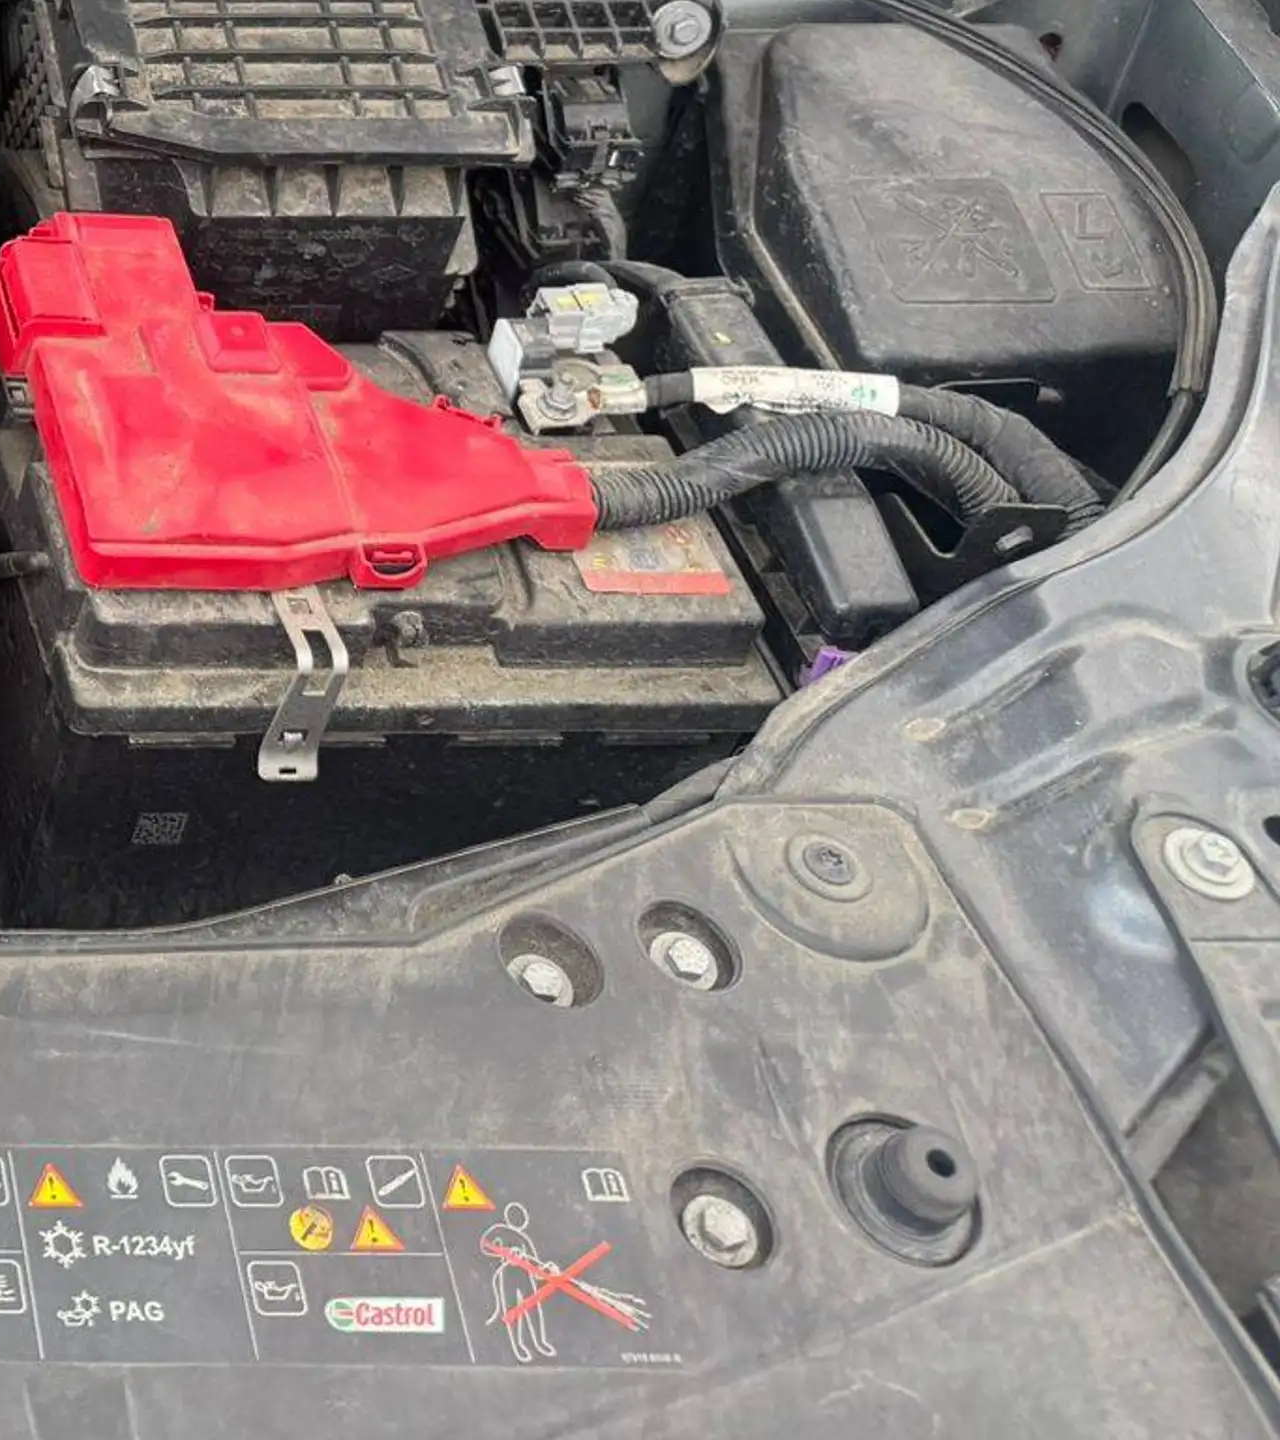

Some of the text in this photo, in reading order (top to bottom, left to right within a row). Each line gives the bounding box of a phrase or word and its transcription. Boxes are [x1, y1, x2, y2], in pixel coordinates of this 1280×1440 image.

[91, 1234, 196, 1260] R-1234yf
[108, 1299, 166, 1321] PAG
[355, 1301, 436, 1326] Castrol
